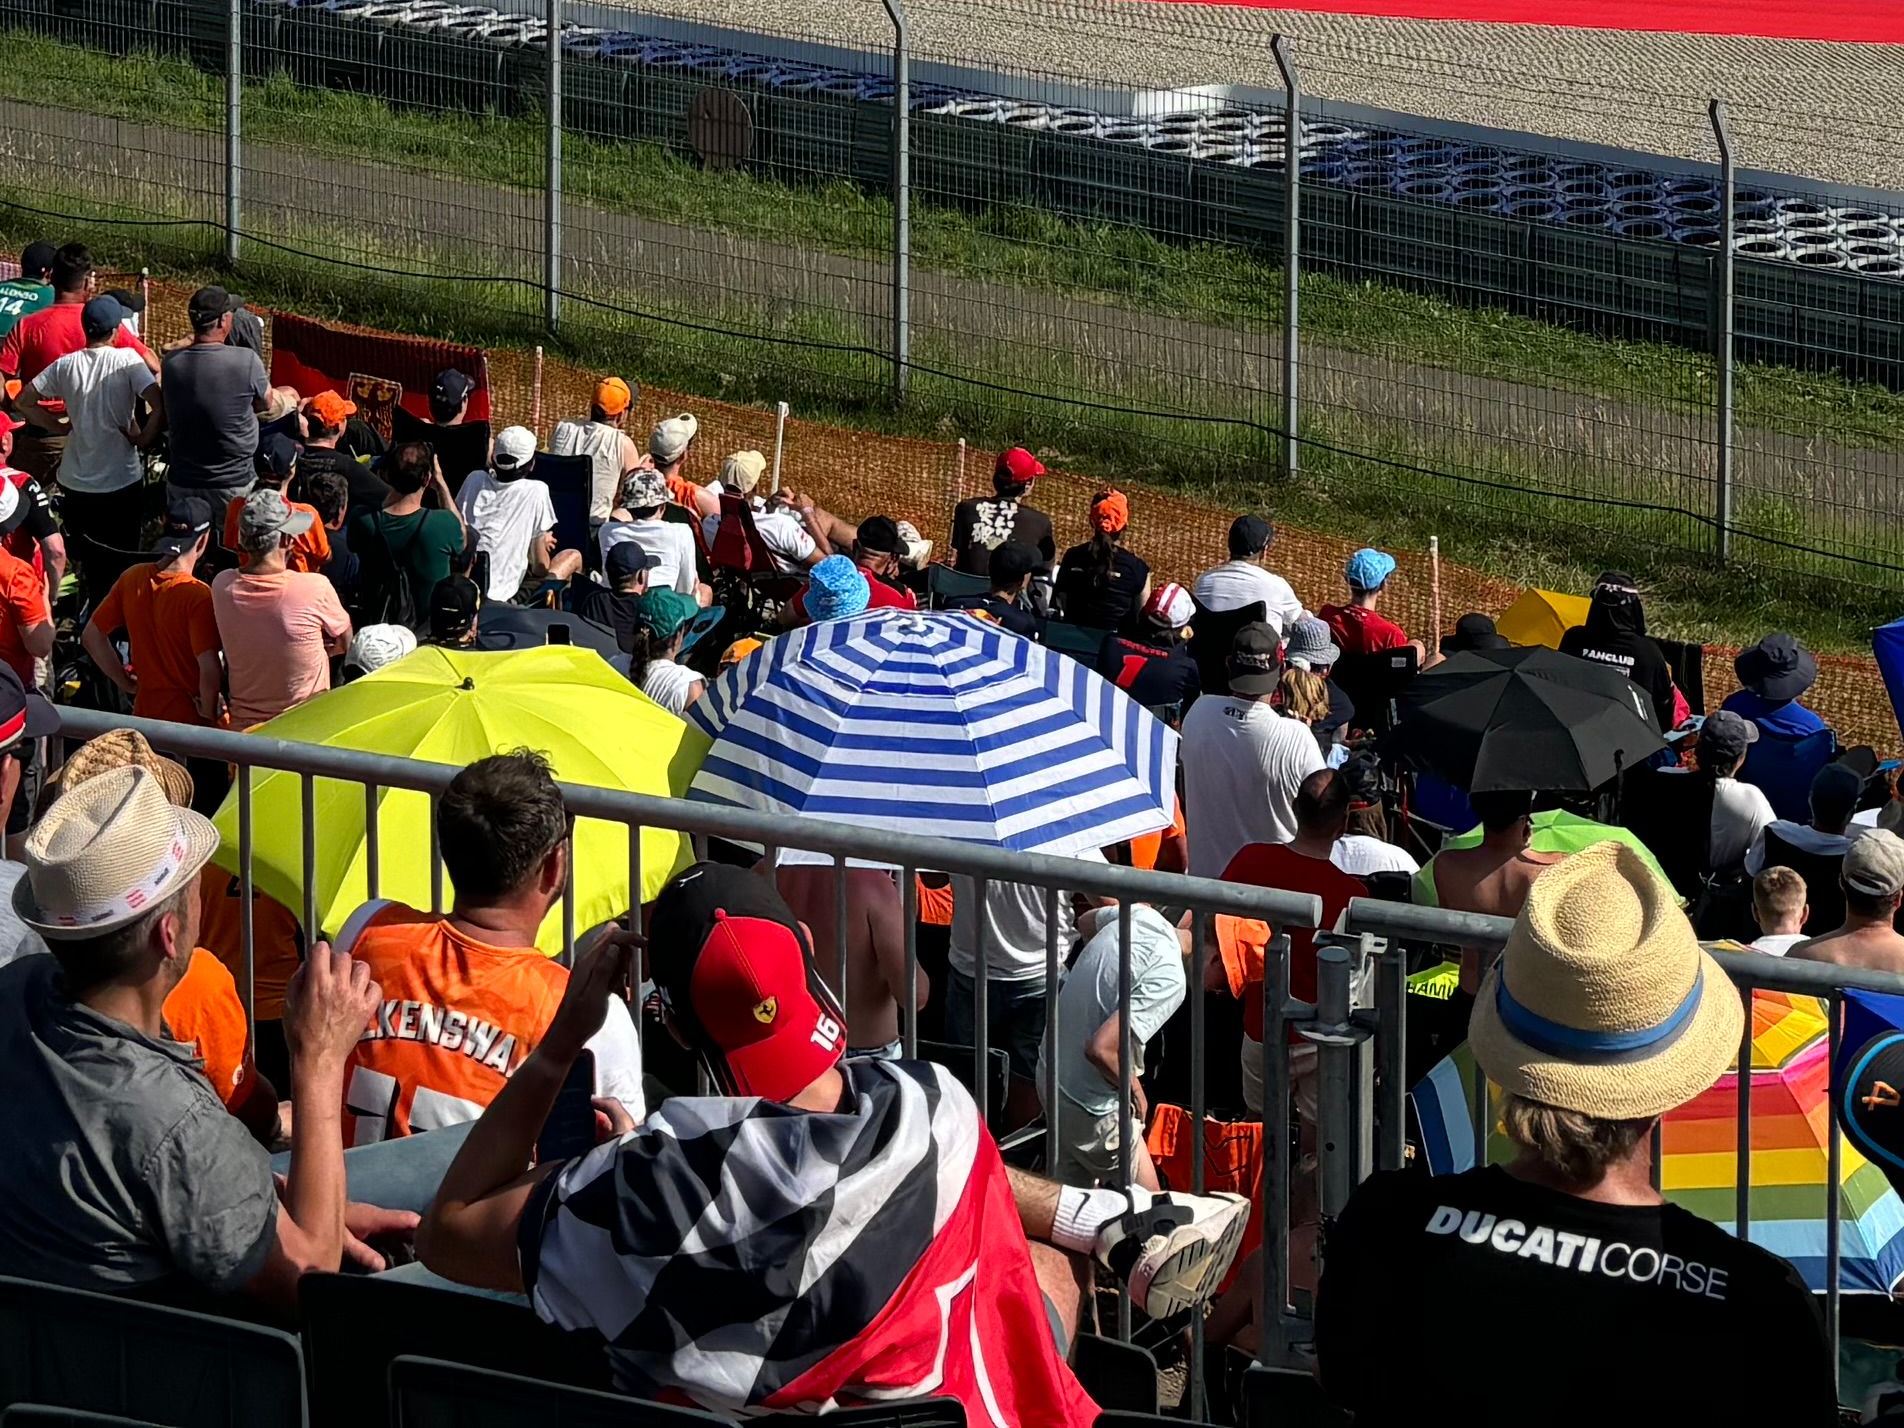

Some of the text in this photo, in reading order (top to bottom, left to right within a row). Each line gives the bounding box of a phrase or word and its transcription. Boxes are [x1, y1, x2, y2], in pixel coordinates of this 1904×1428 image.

[0, 287, 39, 301] ALONSO
[1582, 648, 1635, 666] FANCLUB
[360, 999, 528, 1081] KENSWA
[810, 1012, 840, 1052] 16
[1862, 1081, 1901, 1112] 4
